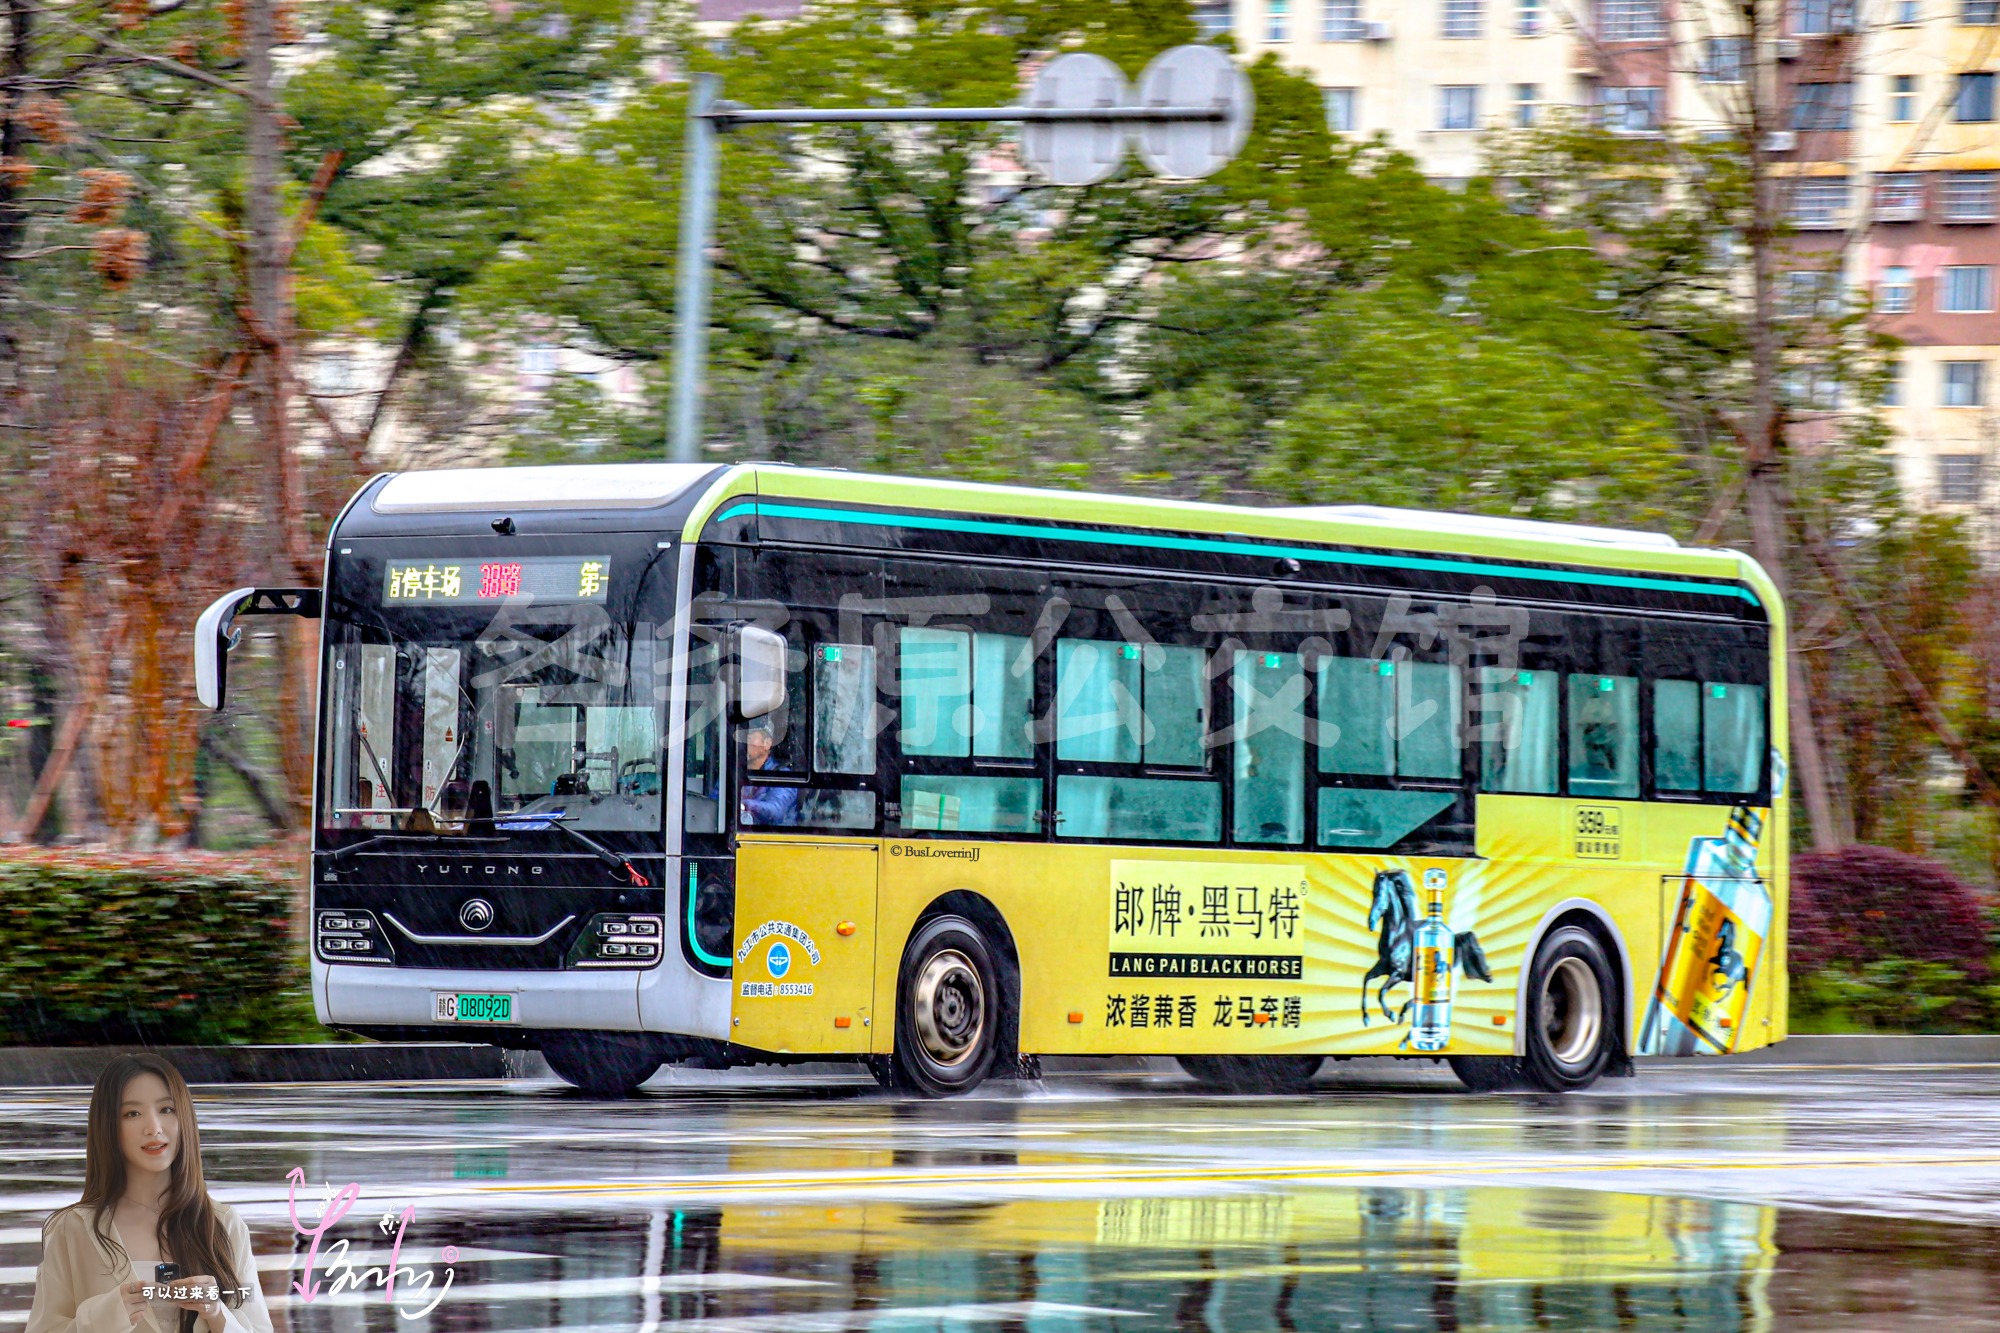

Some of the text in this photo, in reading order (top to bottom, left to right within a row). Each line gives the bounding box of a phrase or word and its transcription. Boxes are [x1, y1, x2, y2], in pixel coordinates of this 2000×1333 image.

[417, 864, 543, 875] YUTONG
[1114, 881, 1300, 940] 郎牌·黑马特
[737, 920, 820, 966] 九江市公共交通集团公司
[1112, 957, 1300, 975] LANG PAI BLACK HORSE
[461, 997, 509, 1018] 08092D
[1105, 993, 1302, 1029] 浓酱兼香 龙马奔腾
